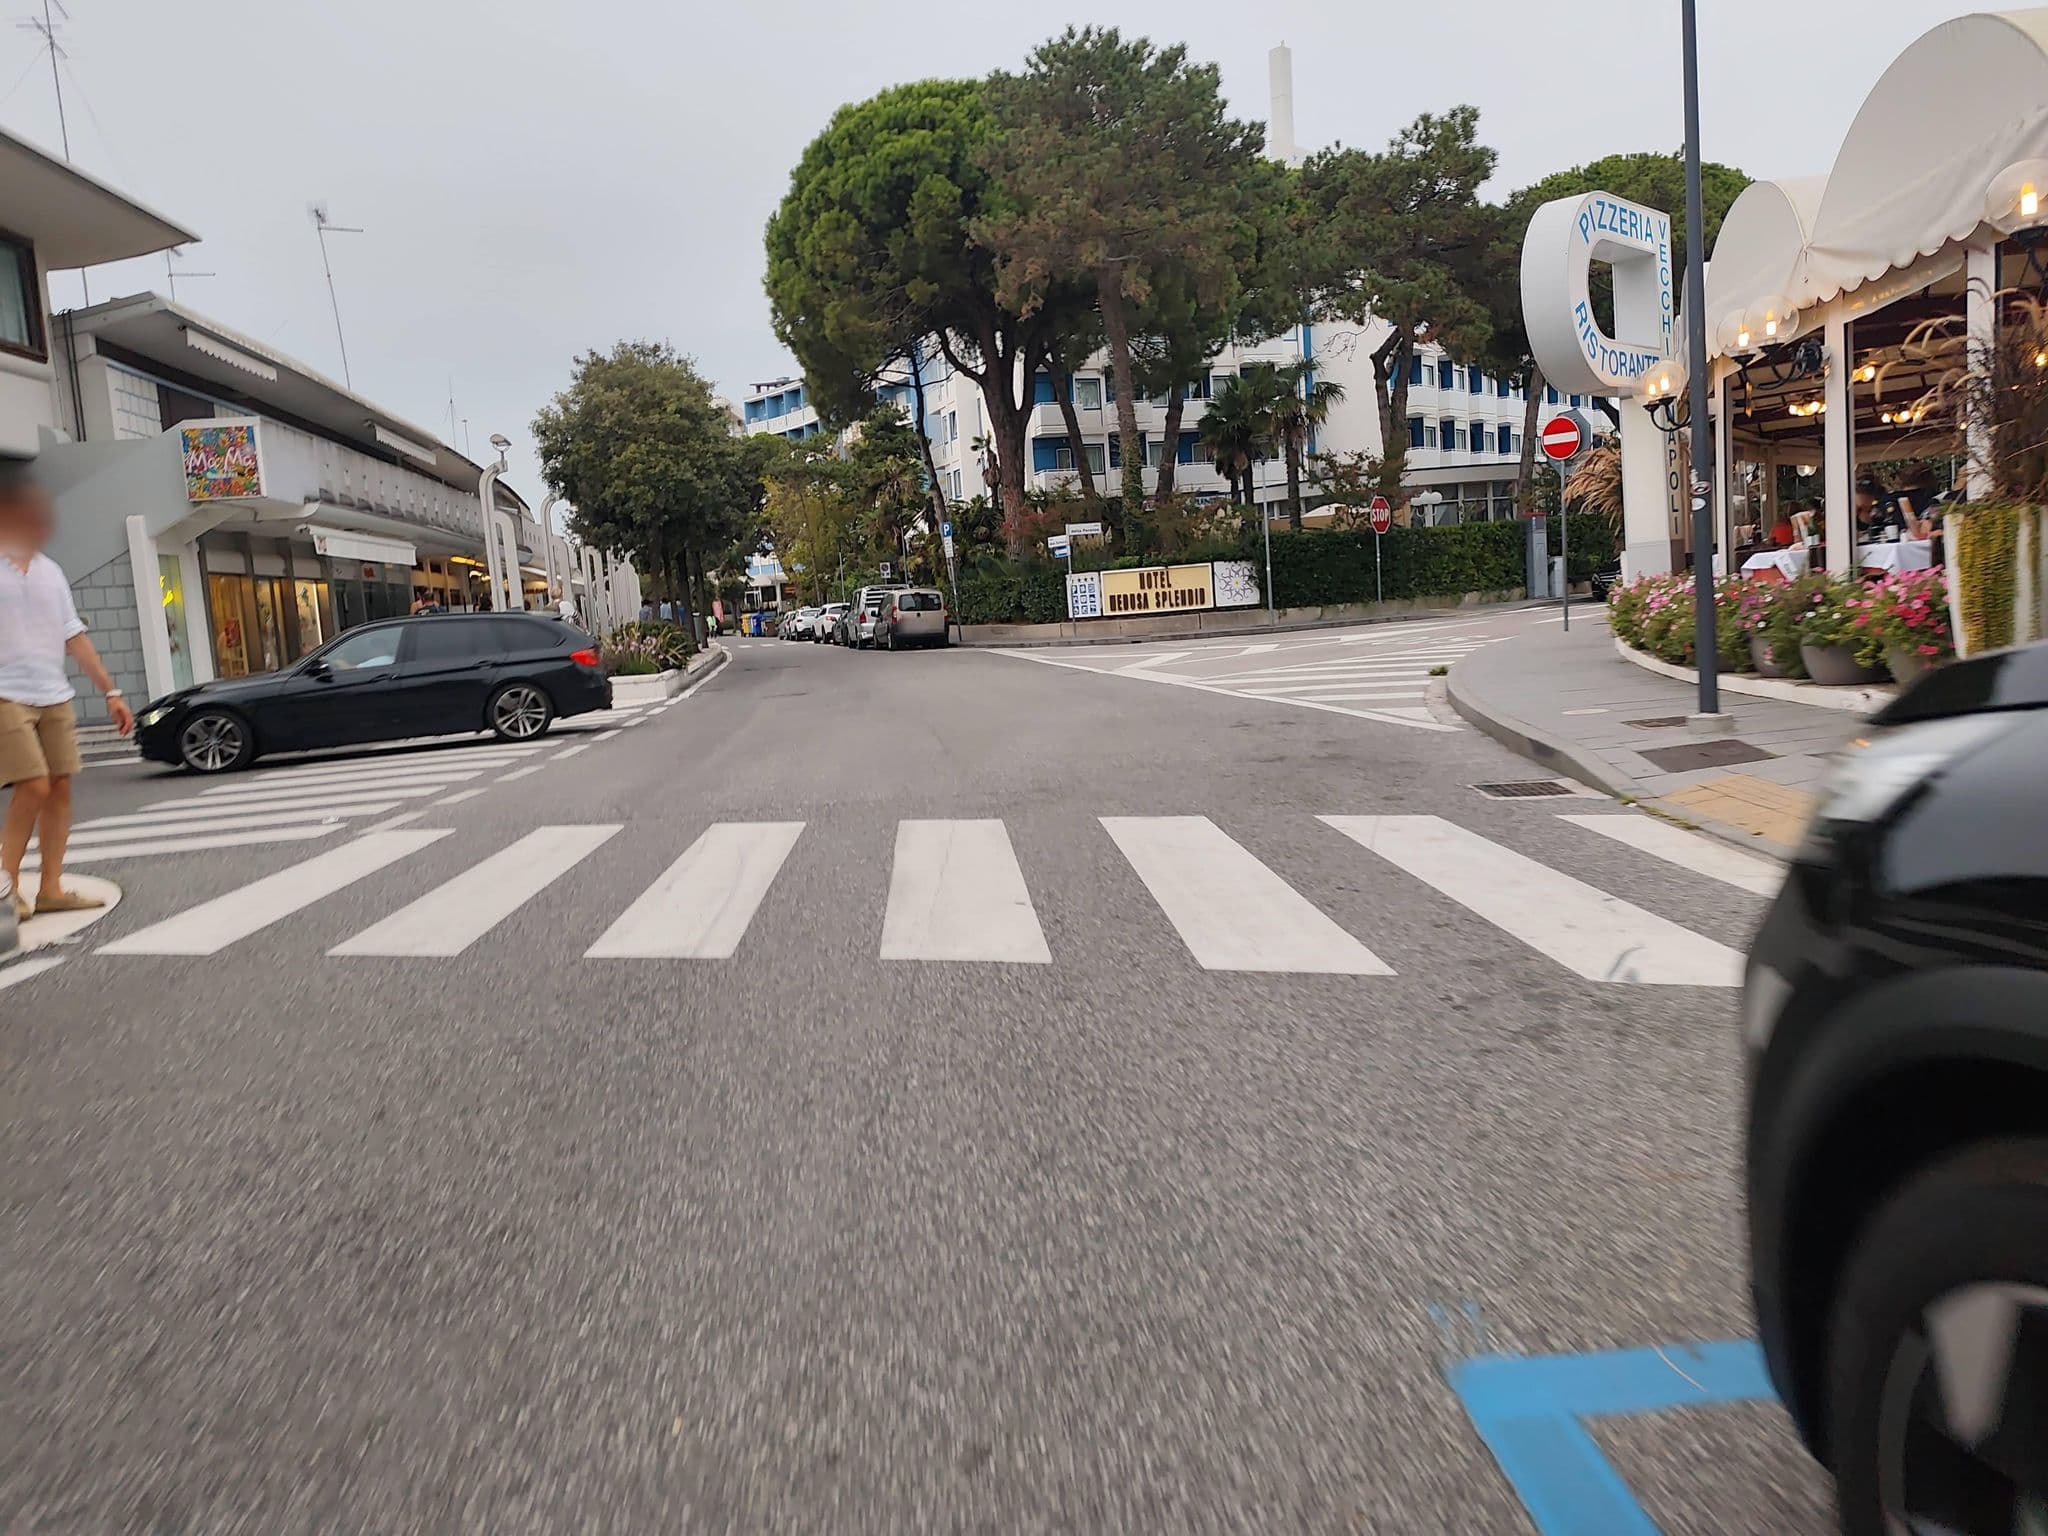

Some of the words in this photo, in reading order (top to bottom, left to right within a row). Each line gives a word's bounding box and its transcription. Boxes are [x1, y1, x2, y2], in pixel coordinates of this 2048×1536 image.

[1579, 200, 1655, 245] PIZZERIA
[1372, 508, 1389, 522] STOP
[1139, 570, 1172, 590] HOTEL
[1109, 592, 1149, 612] MEDUSA
[1155, 587, 1206, 609] SPLENDID
